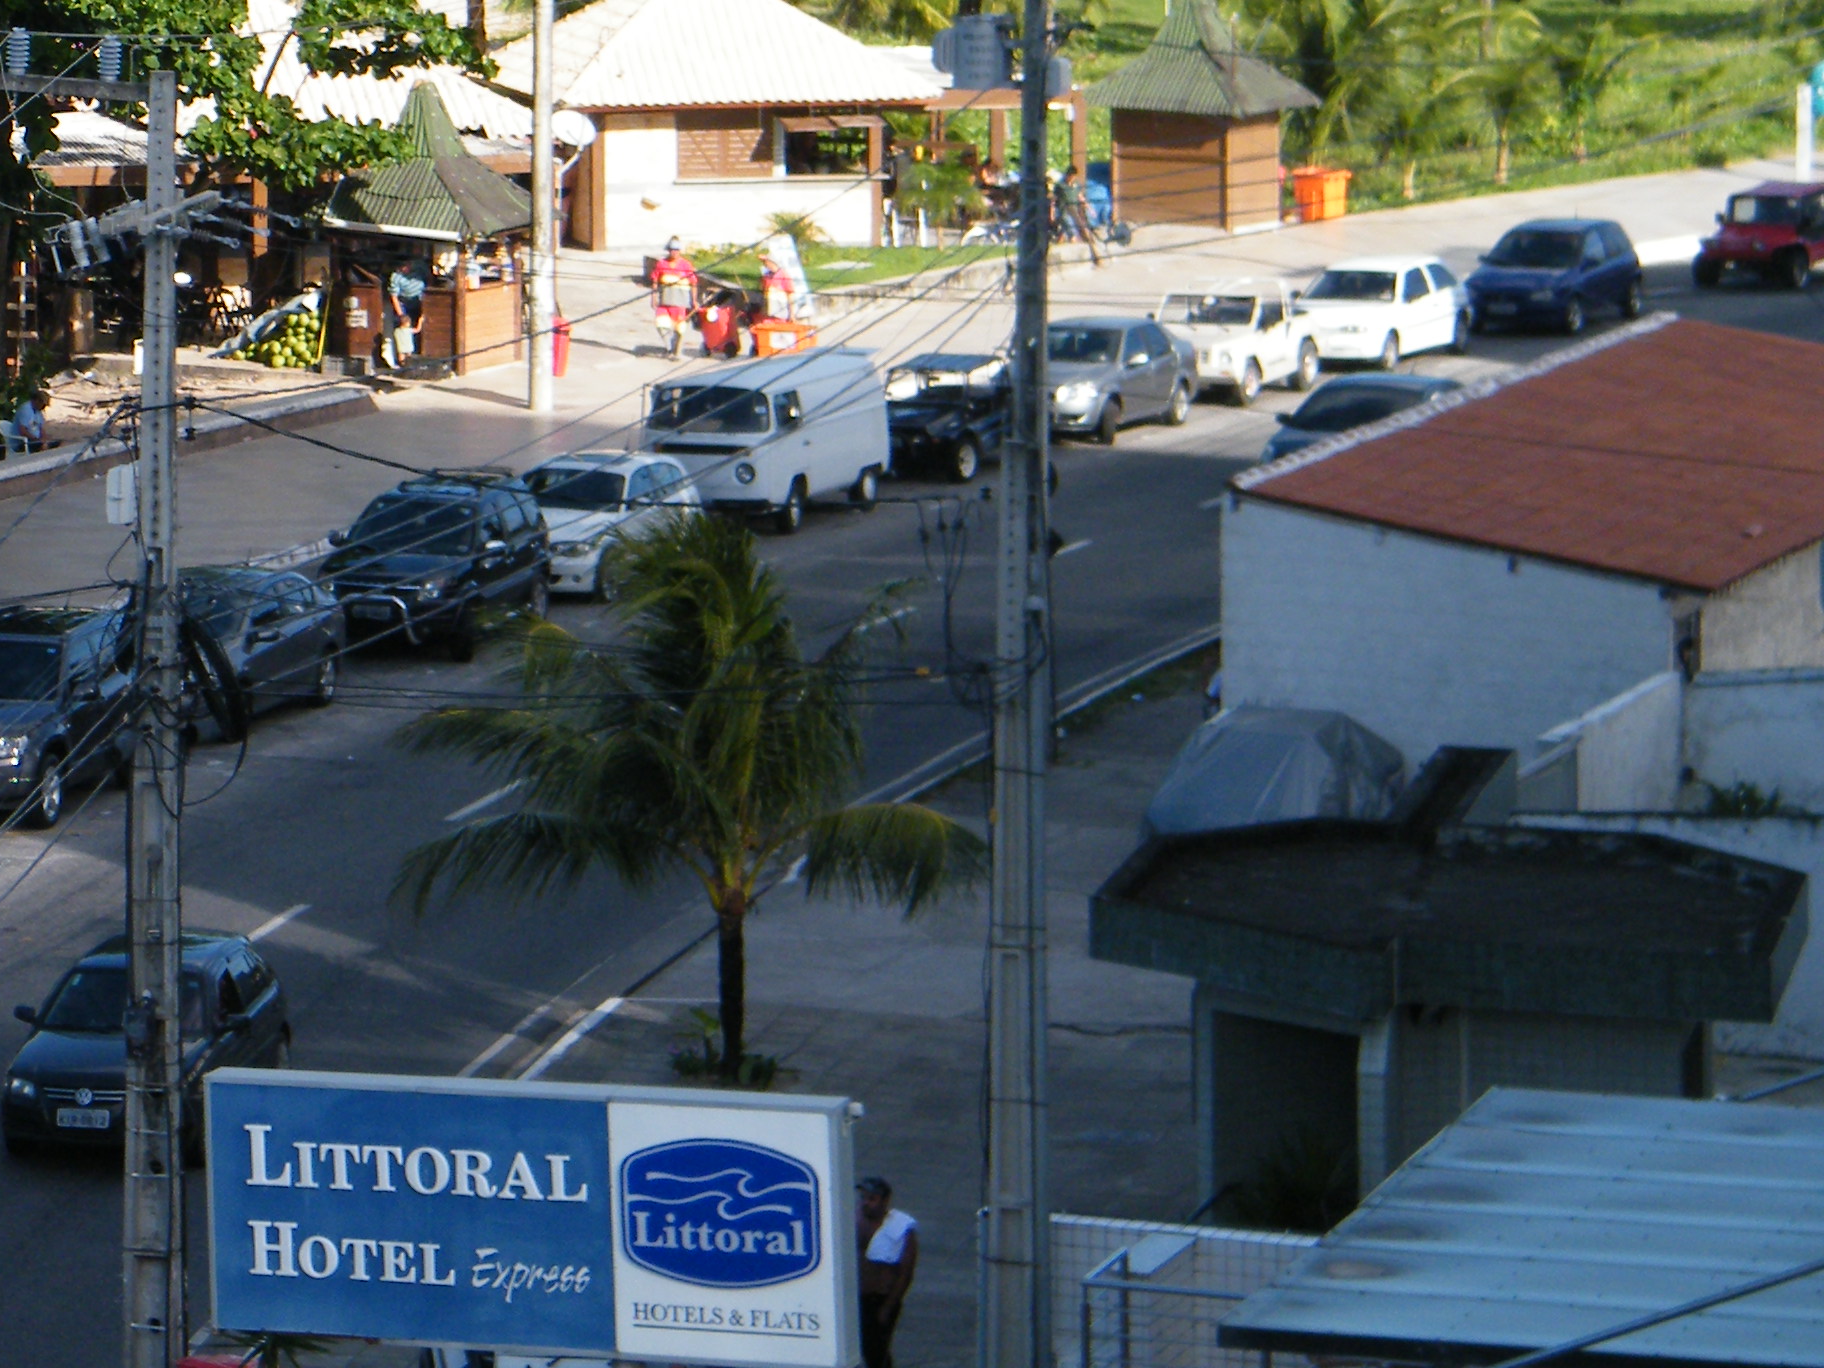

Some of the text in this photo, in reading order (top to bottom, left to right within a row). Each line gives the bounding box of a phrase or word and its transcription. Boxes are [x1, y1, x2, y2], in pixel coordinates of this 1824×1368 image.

[244, 1122, 589, 1203] LITTORAL
[248, 1220, 592, 1303] HOTEL Express
[632, 1210, 808, 1258] Littoral
[632, 1301, 821, 1332] HOTELS & FLATS
